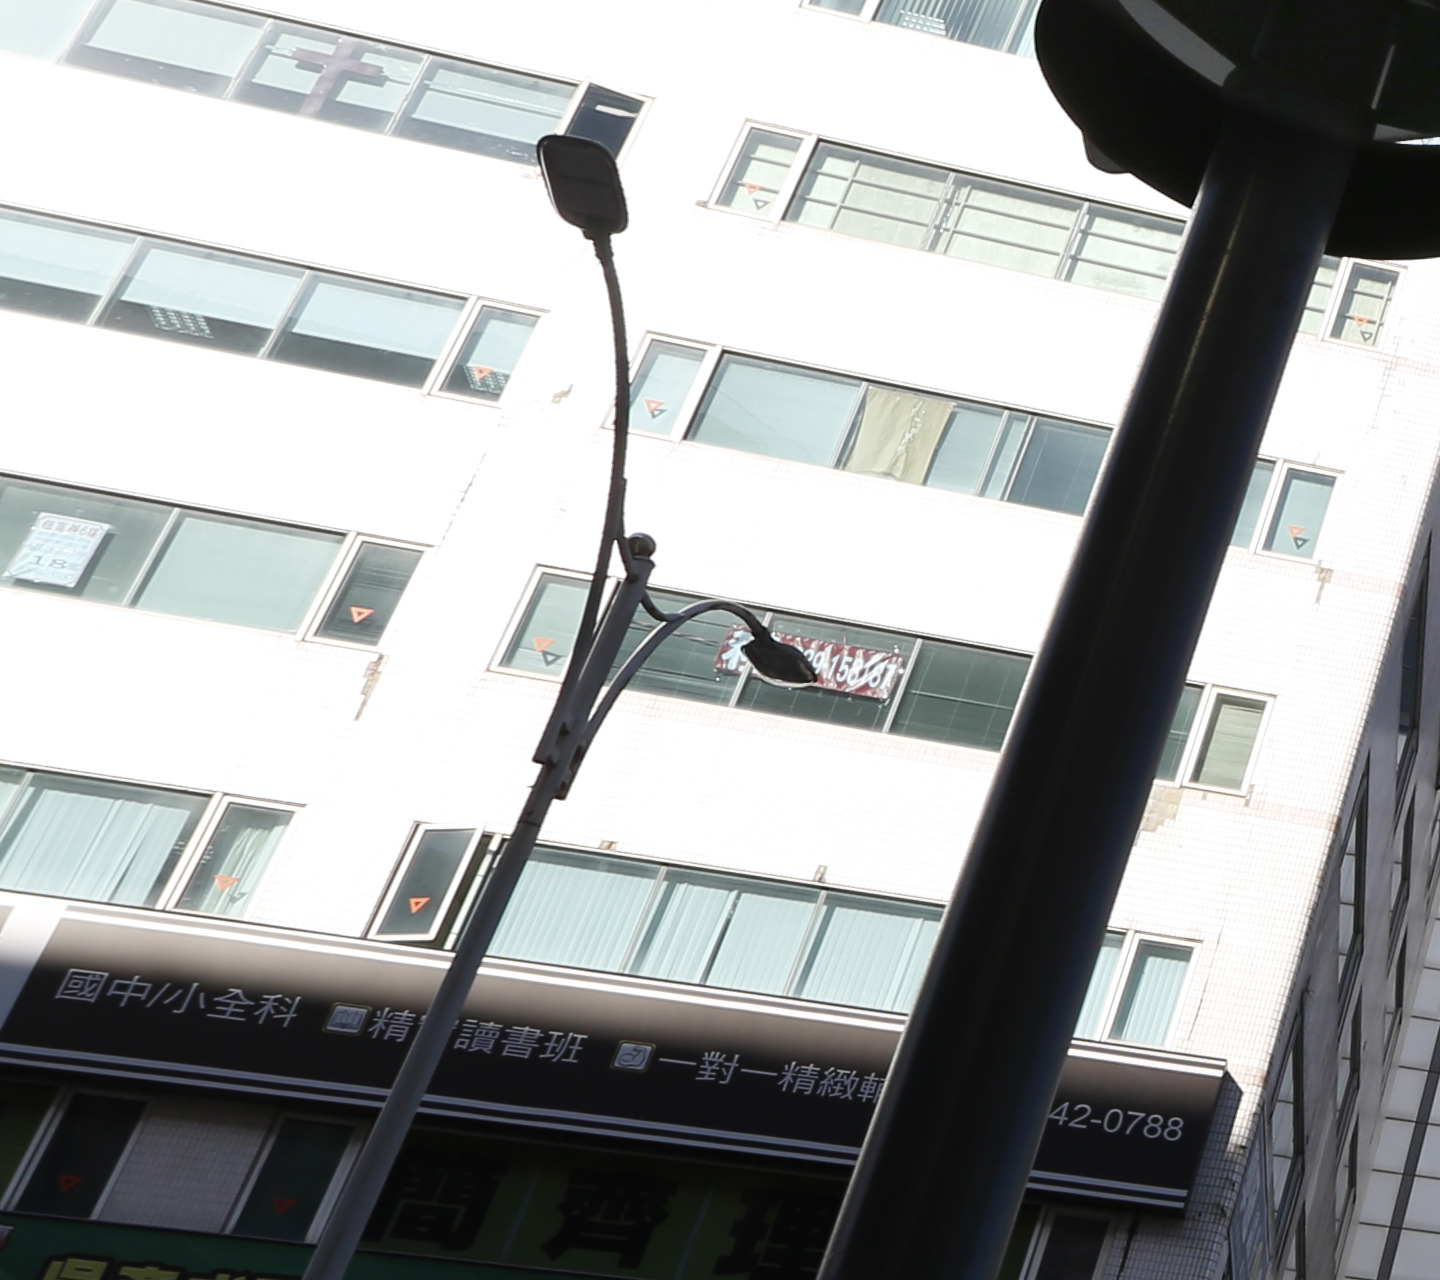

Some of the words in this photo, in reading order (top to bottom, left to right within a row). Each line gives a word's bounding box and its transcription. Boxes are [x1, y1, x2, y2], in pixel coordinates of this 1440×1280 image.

[53, 968, 303, 1028] 國中/小全科
[368, 1004, 588, 1064] 精讀書班
